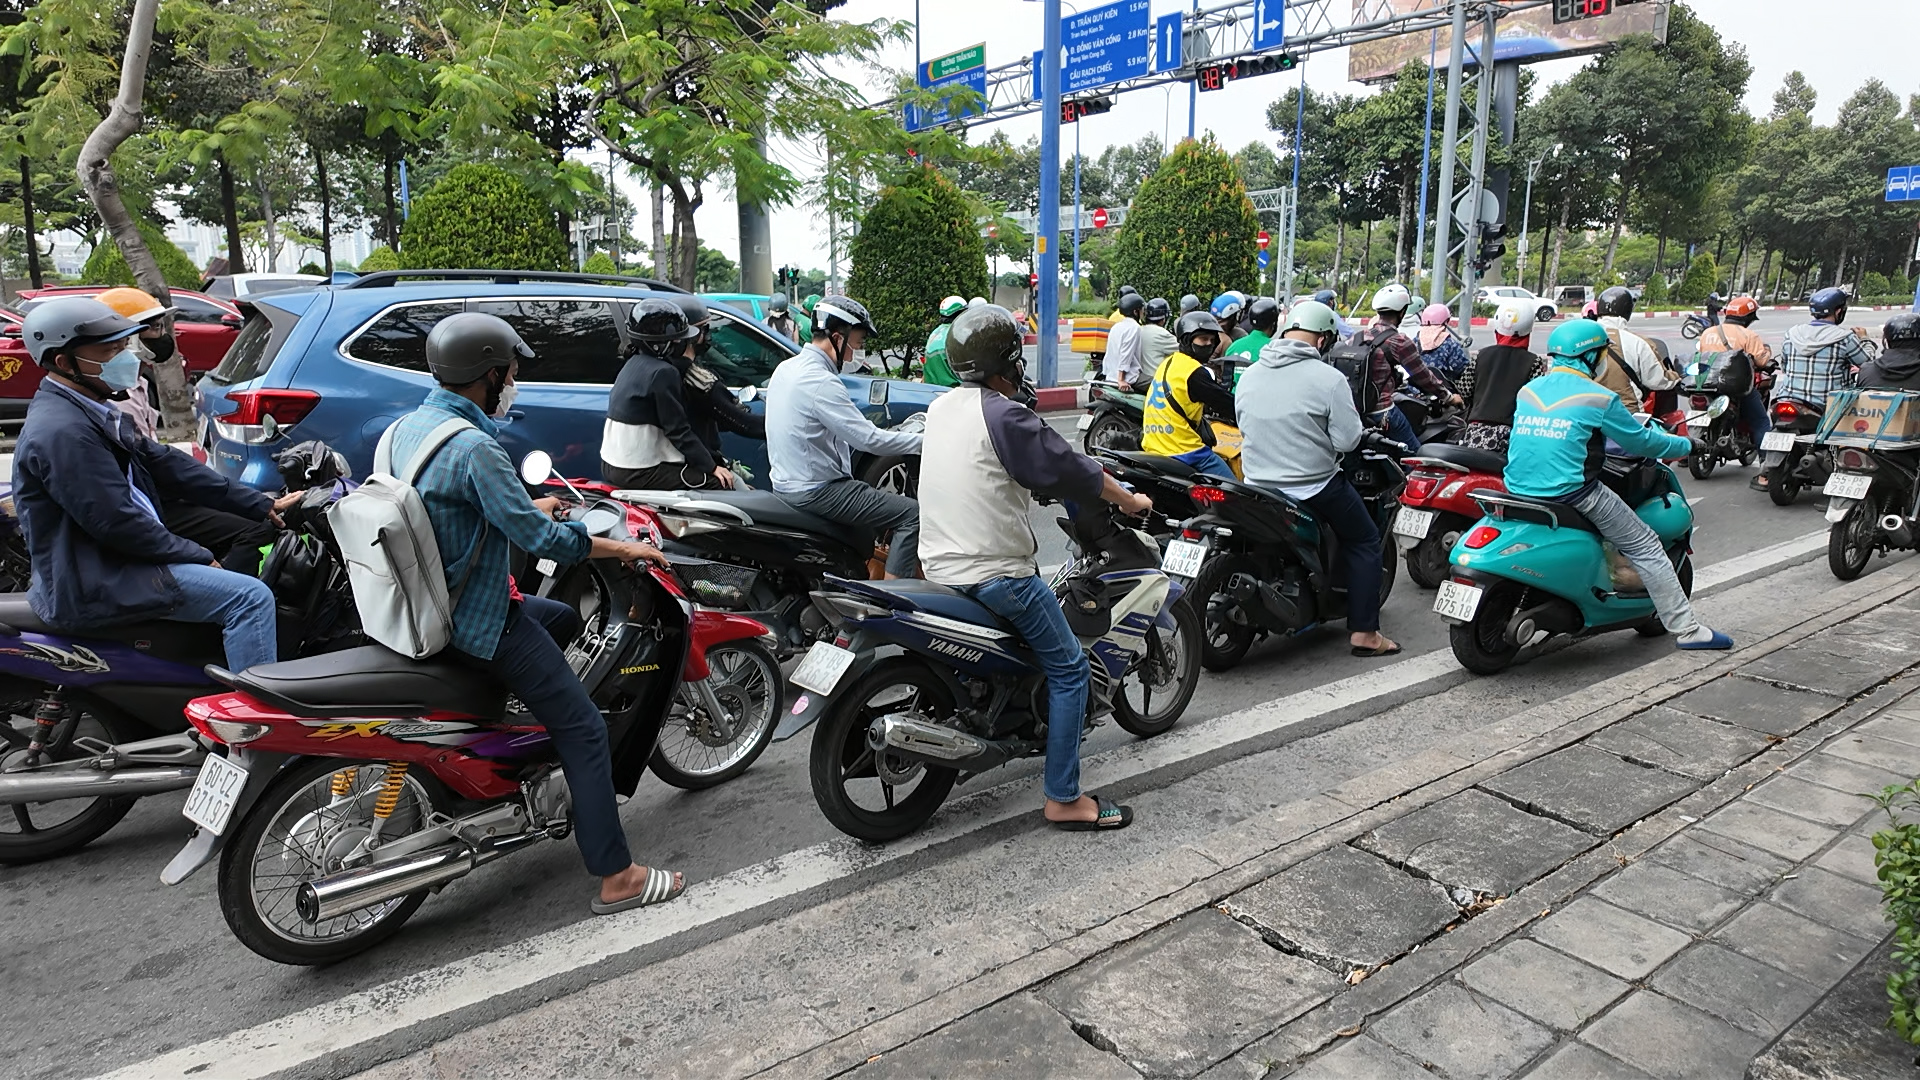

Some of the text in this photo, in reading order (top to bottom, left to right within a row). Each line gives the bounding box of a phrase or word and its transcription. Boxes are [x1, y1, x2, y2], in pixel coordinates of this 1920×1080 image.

[1129, 1, 1148, 12] 1.5 Km
[1077, 15, 1092, 27] TRẦN
[1104, 8, 1118, 20] KIÊN
[1128, 28, 1147, 39] 2.8 Km
[1076, 40, 1092, 54] ĐỒNG
[1105, 33, 1121, 45] CỐNG
[1127, 56, 1147, 66] 5.9 Km
[1070, 60, 1113, 80] CẦU RẠCH CHIẾC
[1092, 76, 1106, 85] Bridge
[1515, 425, 1531, 436] xin
[1516, 415, 1573, 431] XANH SM
[1829, 485, 1861, 497] 2960
[1163, 557, 1198, 575] 409.42
[1436, 598, 1472, 619] 075.18
[927, 638, 984, 664] YAMAHA
[620, 663, 660, 675] HONDA
[306, 720, 391, 742] ZX
[189, 787, 231, 828] 371.97
